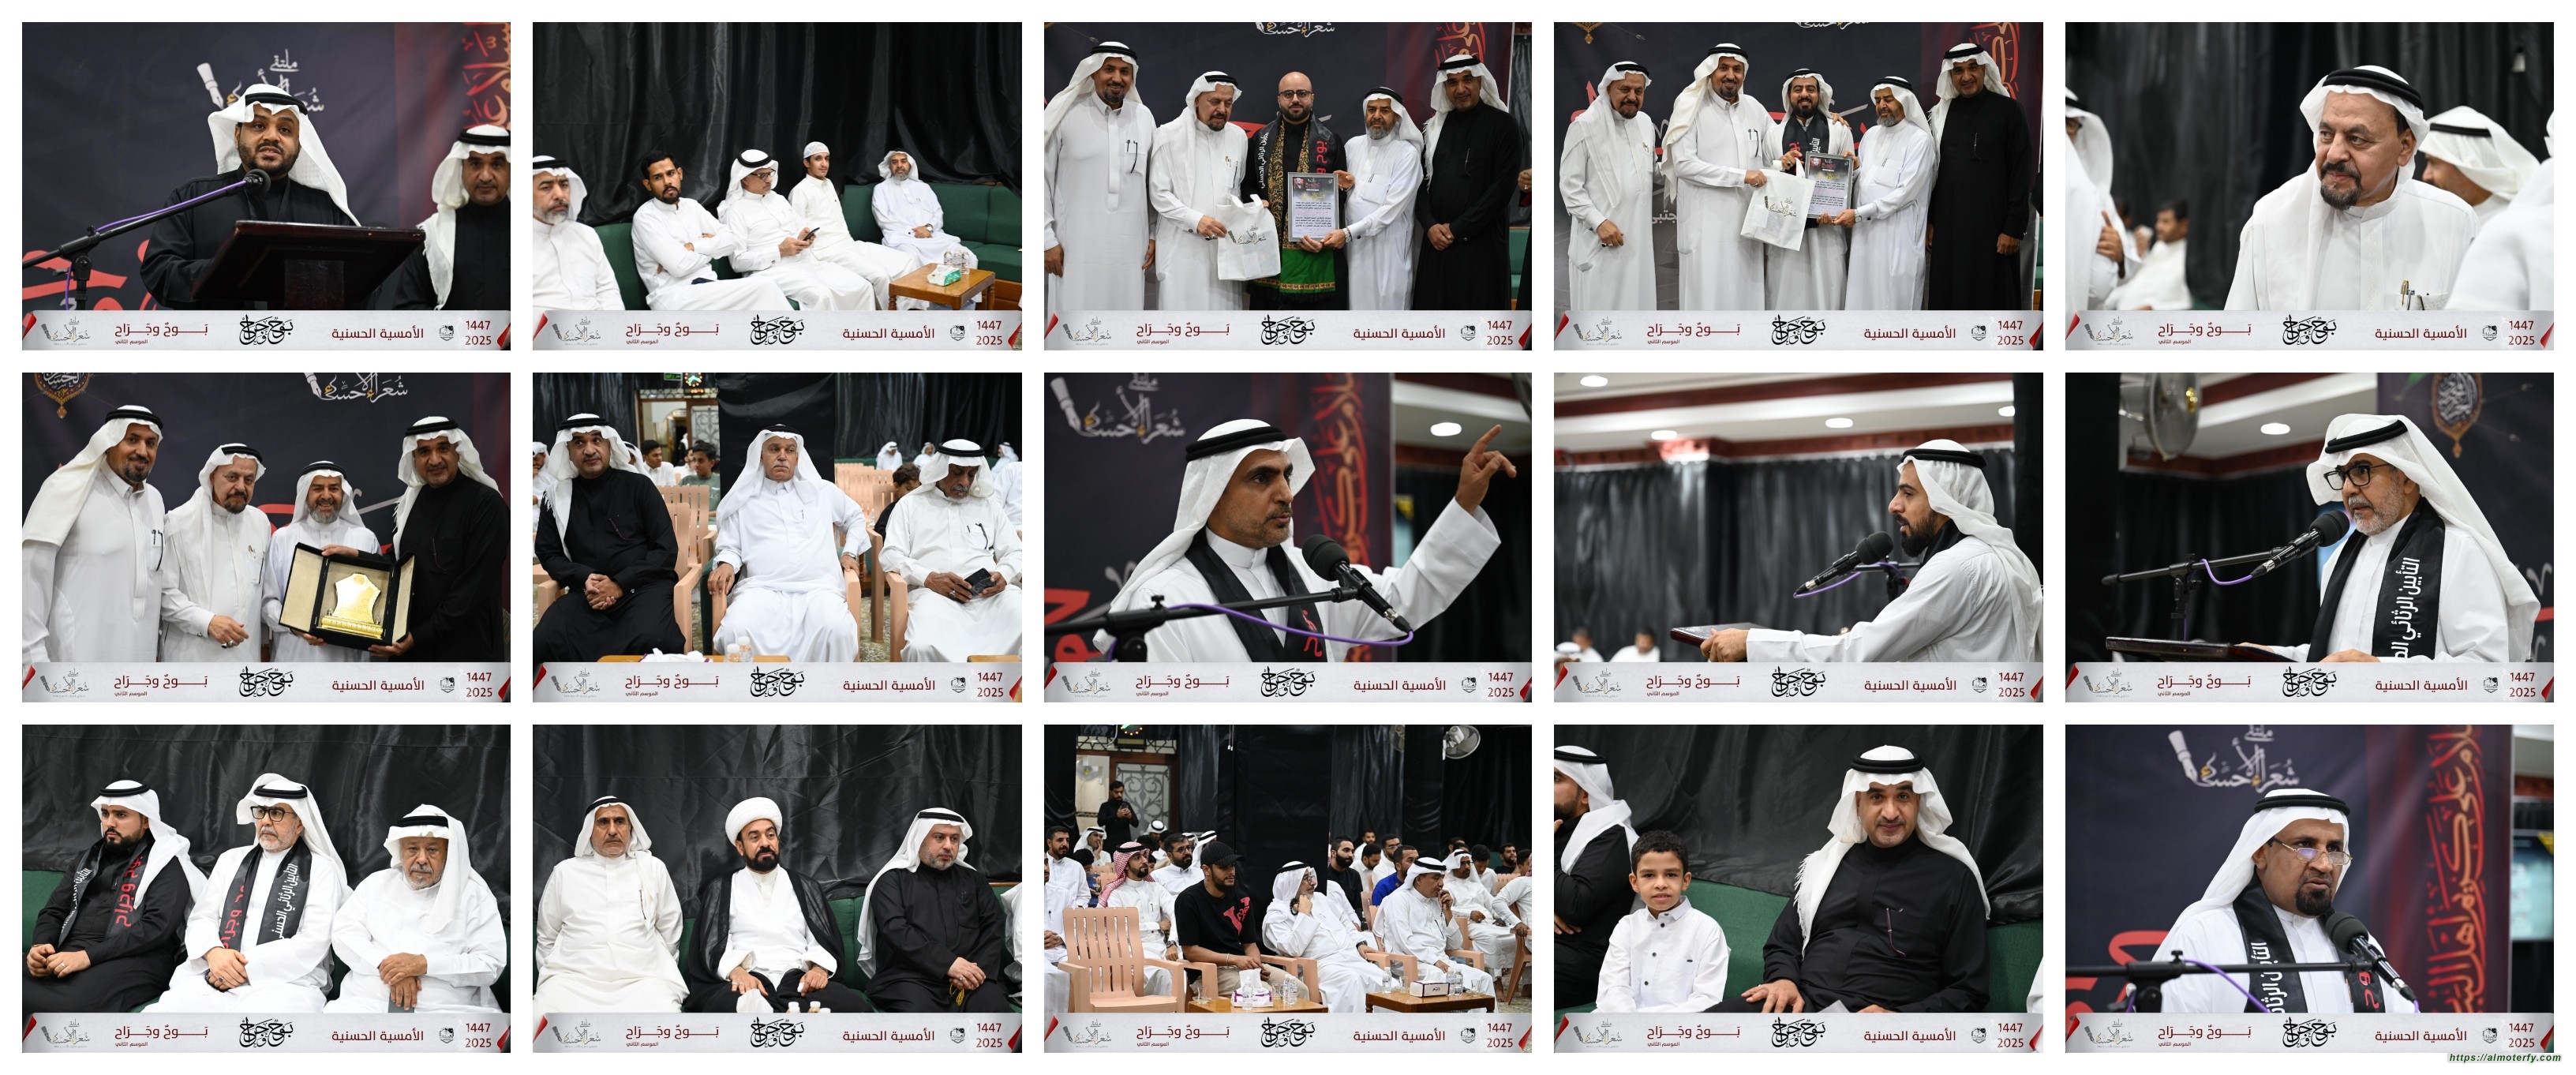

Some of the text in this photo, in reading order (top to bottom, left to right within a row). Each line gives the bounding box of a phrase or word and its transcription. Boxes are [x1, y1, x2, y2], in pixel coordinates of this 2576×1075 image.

[2395, 557, 2423, 595] التأبين
[2391, 596, 2422, 641] الرثائي
[283, 863, 300, 886] التأبين
